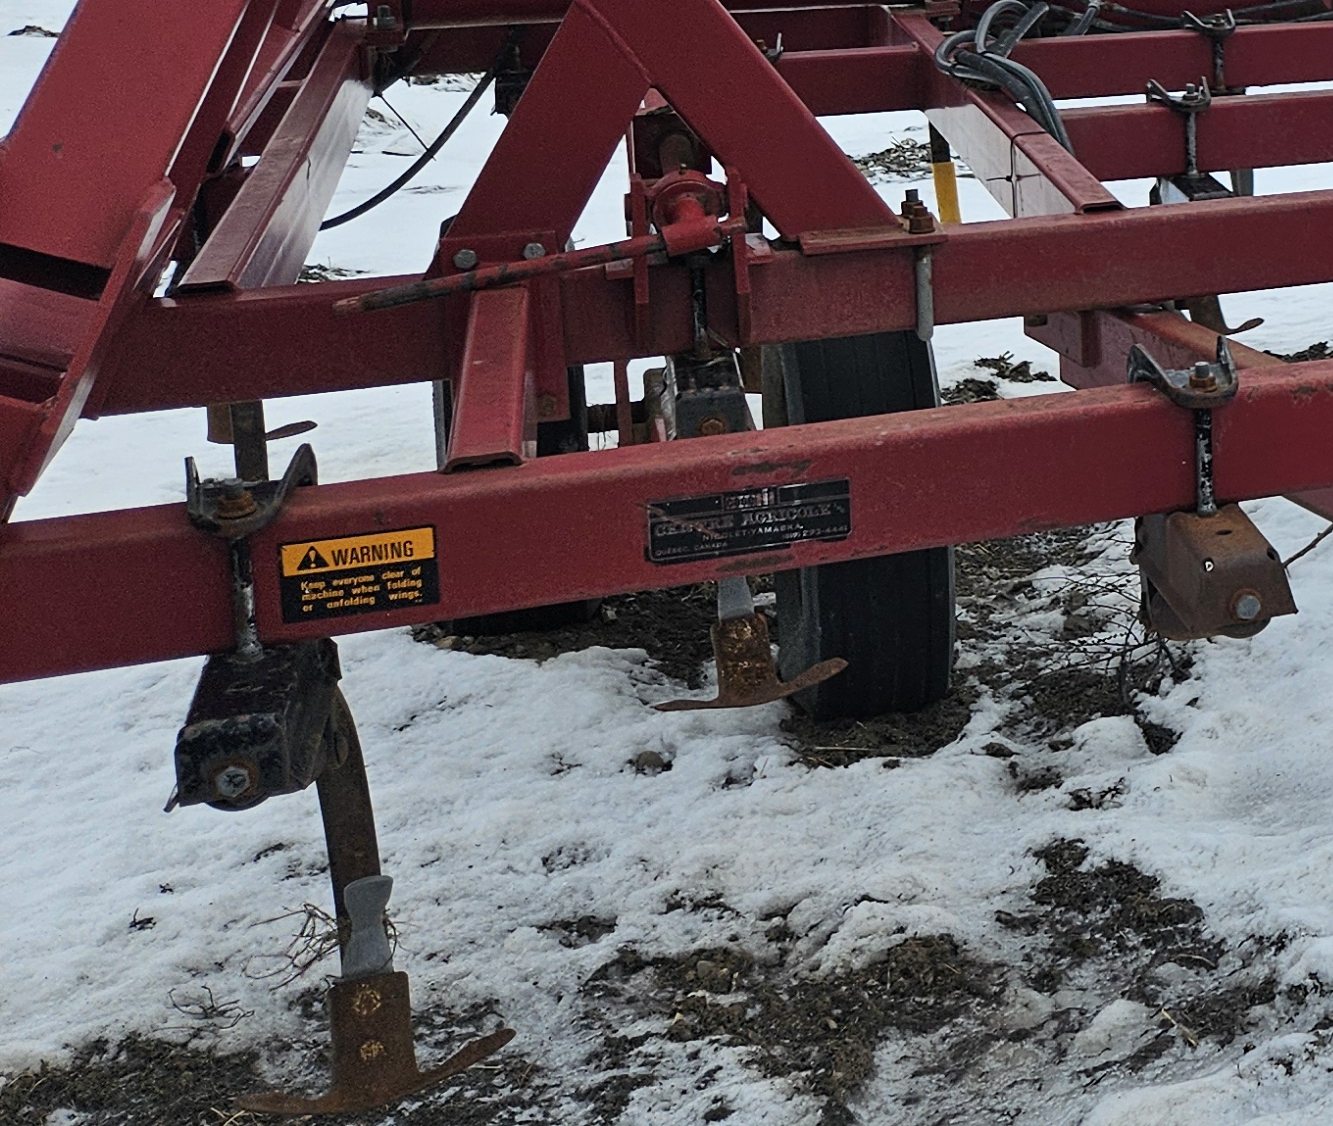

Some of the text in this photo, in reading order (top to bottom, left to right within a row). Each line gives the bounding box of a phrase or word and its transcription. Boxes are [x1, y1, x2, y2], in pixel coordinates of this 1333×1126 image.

[331, 540, 414, 566] WARNING
[301, 566, 422, 591] Keep everyone clear of
[301, 578, 423, 601] machine when folding
[302, 591, 423, 612] or unfolding wings.
